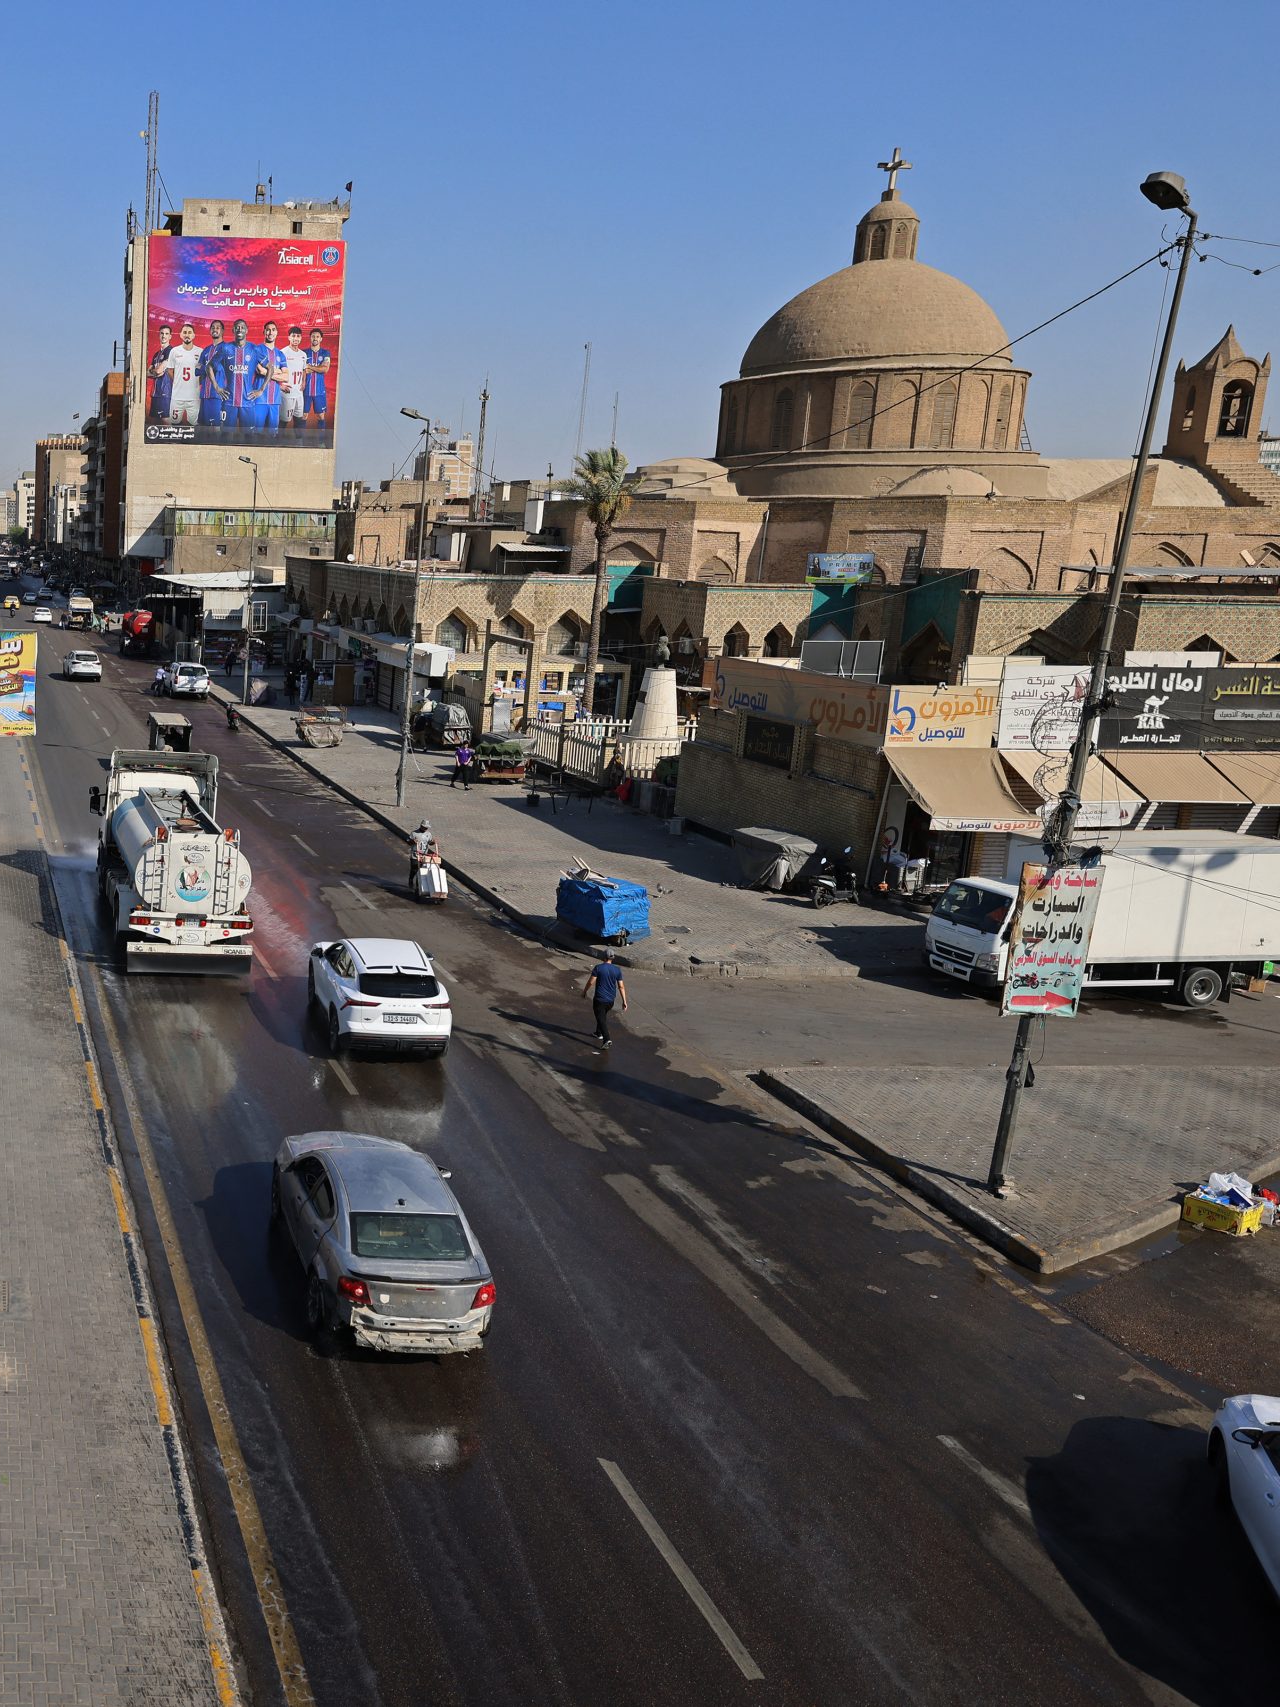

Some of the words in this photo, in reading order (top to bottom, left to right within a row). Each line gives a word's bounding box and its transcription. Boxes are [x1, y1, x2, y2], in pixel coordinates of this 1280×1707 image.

[278, 247, 314, 265] Asiacell
[177, 283, 209, 294] جيرمان
[211, 284, 231, 295] سان
[234, 285, 268, 297] وباريس
[271, 285, 312, 297] آسياسيل
[201, 296, 245, 308] للعالمية
[247, 298, 286, 310] وياكم
[182, 367, 191, 382] 5
[172, 410, 179, 420] 5
[1027, 676, 1055, 687] شركة
[1108, 671, 1157, 693] الخليج
[1162, 672, 1203, 692] رمال
[1213, 675, 1260, 701] النسر
[728, 687, 768, 712] للتوصيل
[1011, 689, 1038, 700] الخليج
[920, 688, 994, 721] الأمزون
[1013, 708, 1036, 717] SADA
[918, 726, 965, 742] للتوصيل
[1120, 734, 1150, 743] العطور
[956, 821, 992, 830] للتوصيل
[1064, 870, 1098, 888] ساحة
[1037, 951, 1058, 967] السوق
